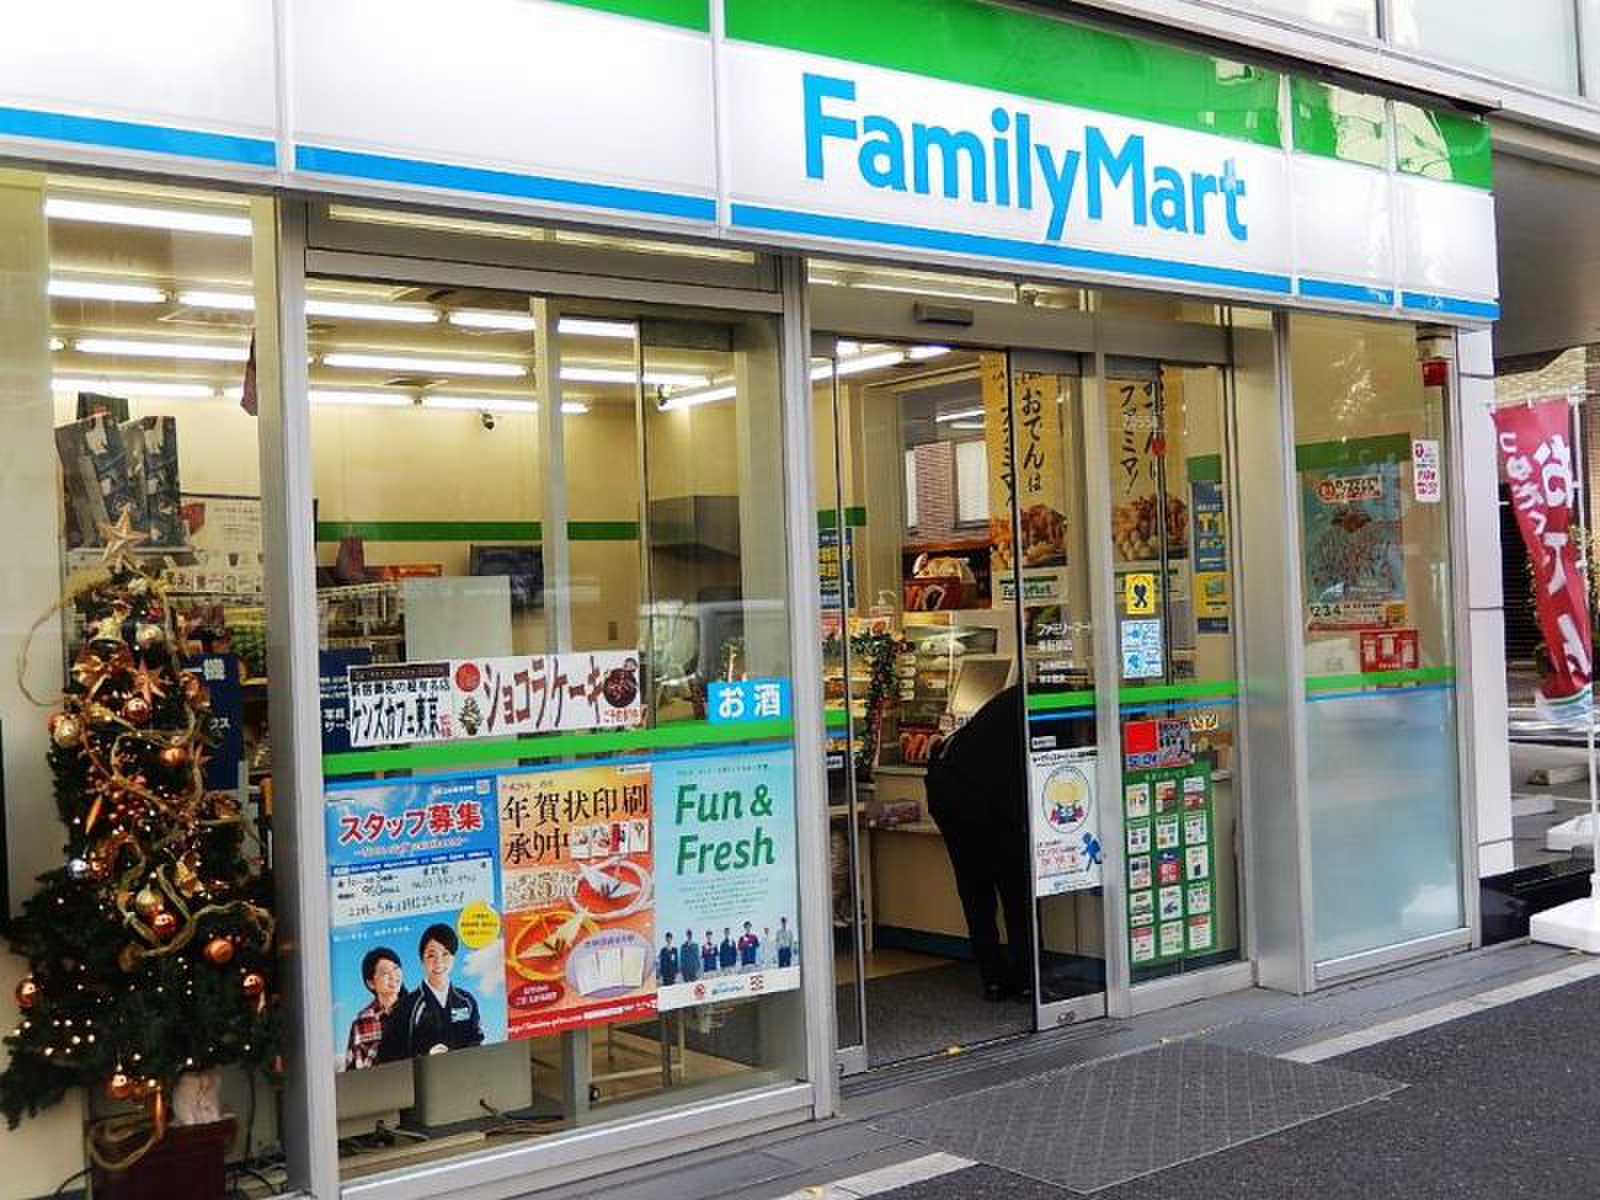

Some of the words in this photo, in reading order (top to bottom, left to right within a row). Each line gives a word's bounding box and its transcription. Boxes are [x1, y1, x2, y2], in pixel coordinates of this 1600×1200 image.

[803, 73, 1248, 241] FamilyMart
[484, 655, 604, 732] ショコラケーキ
[719, 683, 781, 717] お酒
[339, 801, 482, 843] スタッフ募集
[502, 783, 648, 829] 年賀状印刷
[675, 783, 743, 825] Fun
[750, 784, 773, 816] &
[504, 827, 569, 865] 承り中
[677, 827, 775, 875] Fresh
